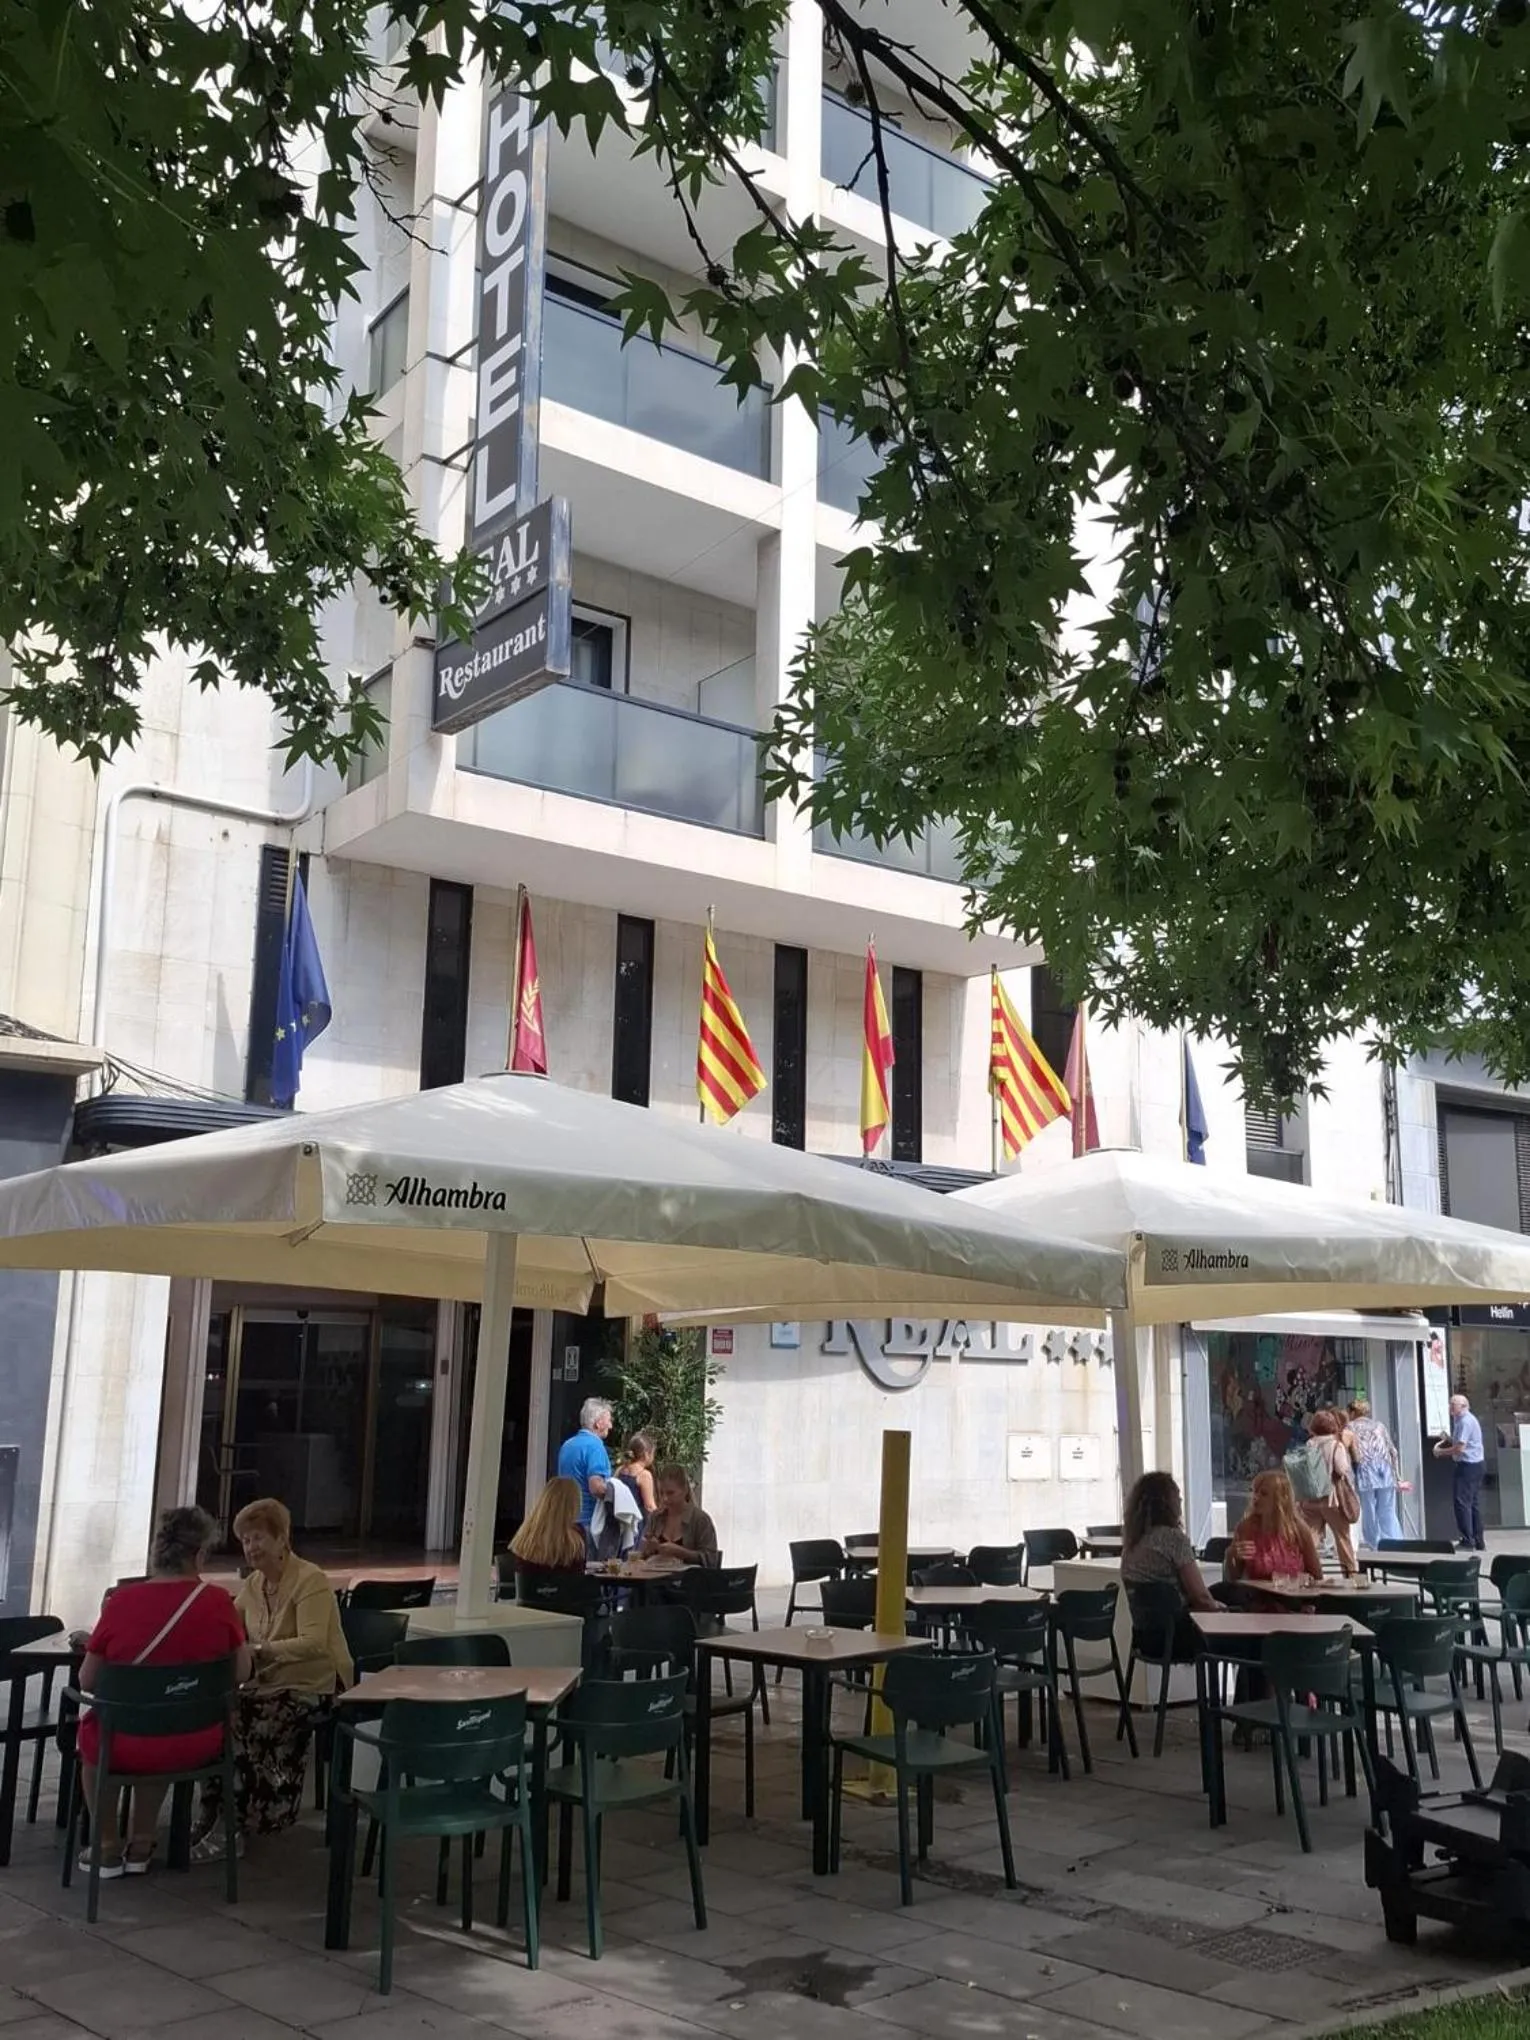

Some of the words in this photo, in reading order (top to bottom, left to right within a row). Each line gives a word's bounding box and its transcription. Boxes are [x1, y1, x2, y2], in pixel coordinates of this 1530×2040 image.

[475, 79, 531, 528] HOTEL
[451, 521, 540, 618] EAL
[438, 612, 546, 700] Restaurant
[384, 1176, 507, 1211] Alhambra
[1183, 1248, 1249, 1271] Alhambra
